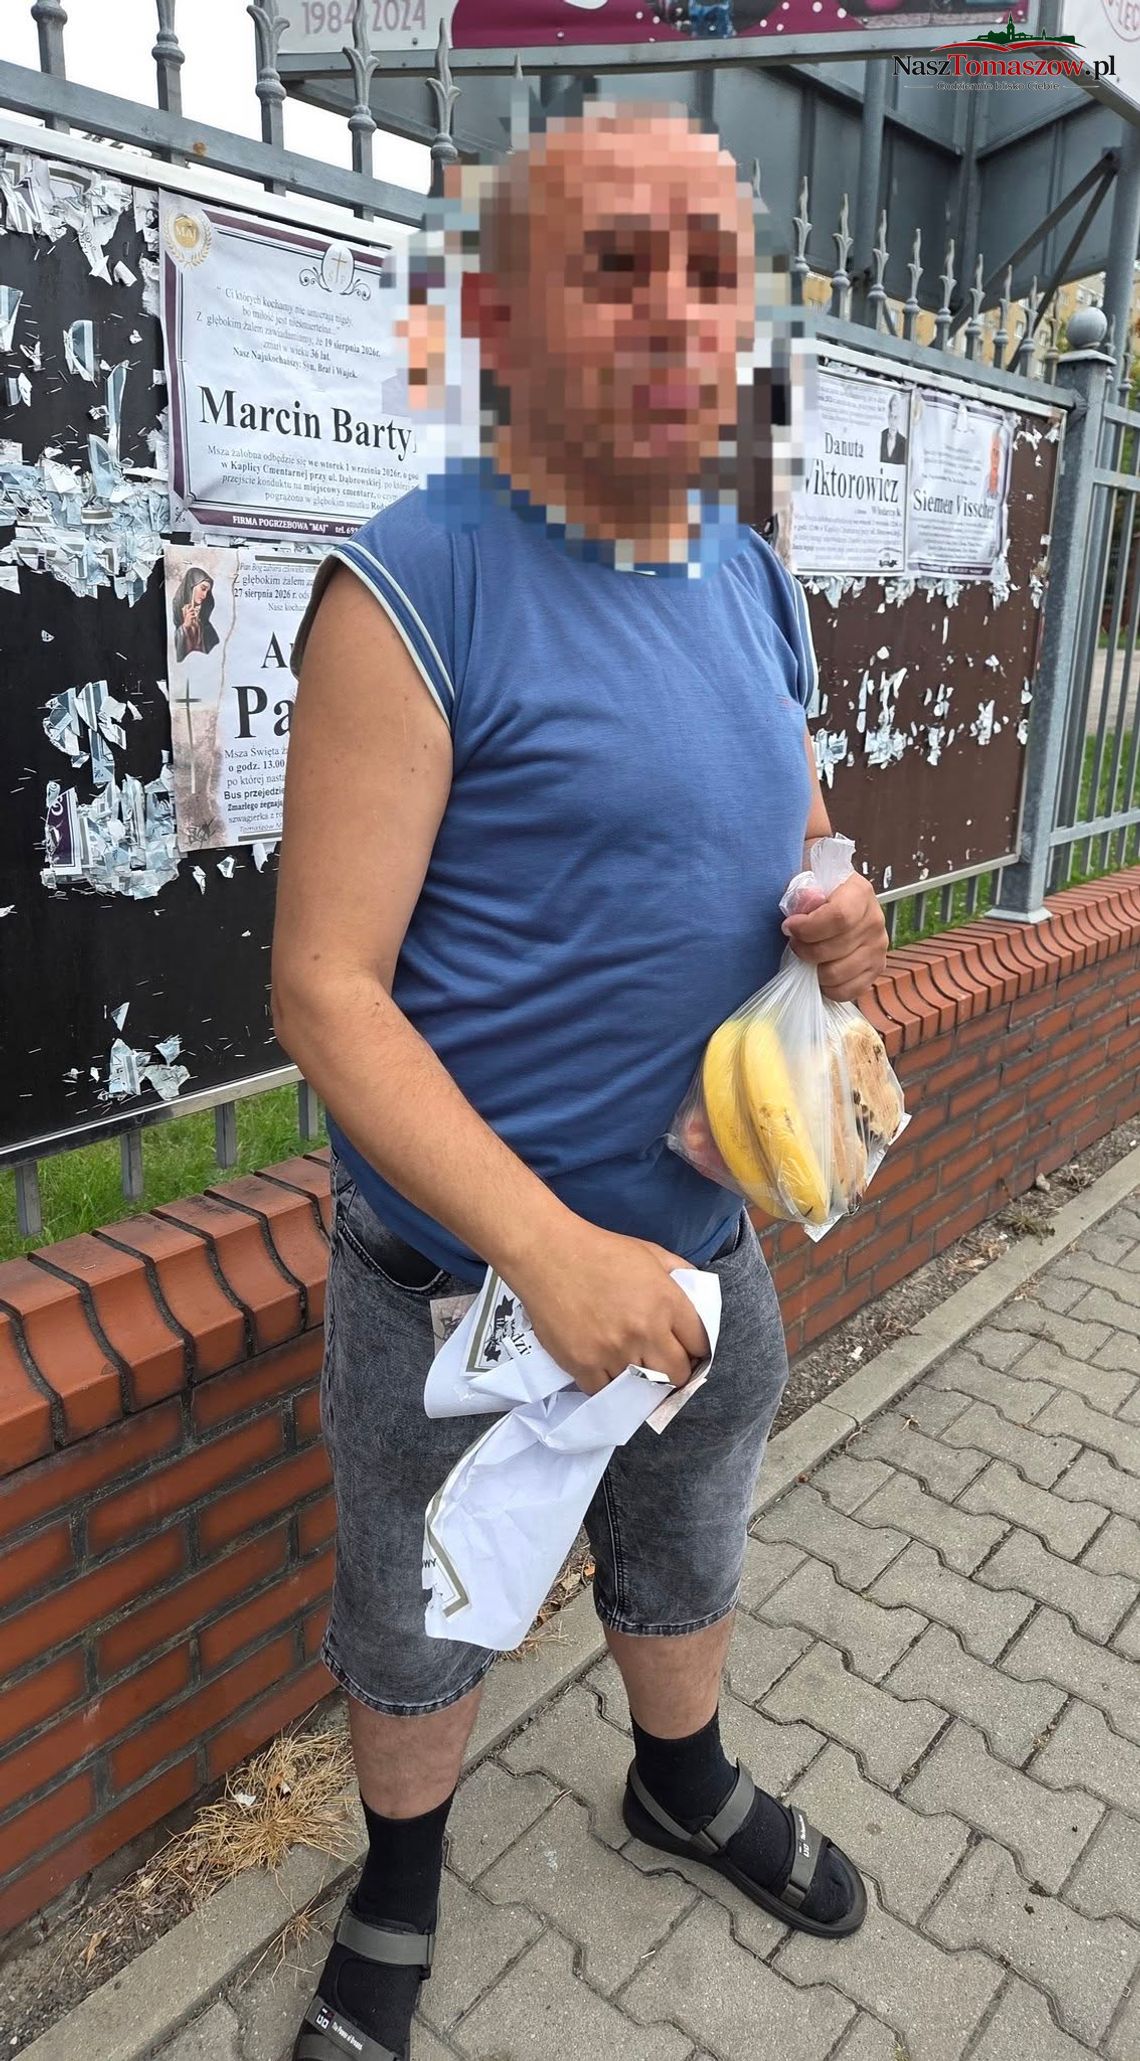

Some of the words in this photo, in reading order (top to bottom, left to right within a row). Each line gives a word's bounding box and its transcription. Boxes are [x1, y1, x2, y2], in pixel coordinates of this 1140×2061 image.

[372, 0, 426, 32] 2024
[197, 385, 321, 440] Marcin
[208, 444, 230, 456] Msza
[824, 432, 864, 458] Danuta
[230, 460, 261, 475] Kaplicy
[262, 464, 308, 481] Cmentarnej
[309, 472, 326, 483] przy
[222, 474, 256, 487] przejście
[257, 476, 292, 489] konduktu
[303, 483, 341, 495] miejscowy
[912, 488, 954, 515] Siemen
[956, 495, 996, 520] Visscher
[232, 515, 258, 526] FIRMA
[258, 518, 309, 530] POGRZEBOWA
[242, 574, 281, 587] głębokim
[233, 588, 243, 598] 27
[244, 588, 273, 601] sierpnia
[274, 589, 291, 599] 2026
[261, 632, 294, 669] A
[231, 686, 295, 739] Pa
[224, 749, 249, 759] Msza
[250, 745, 279, 757] Święta
[228, 765, 234, 773] o
[236, 762, 260, 774] godz.
[263, 760, 285, 770] 13.00
[226, 779, 238, 789] po
[240, 774, 265, 786] której
[223, 791, 242, 800] Bus
[228, 813, 269, 824] szwagierka
